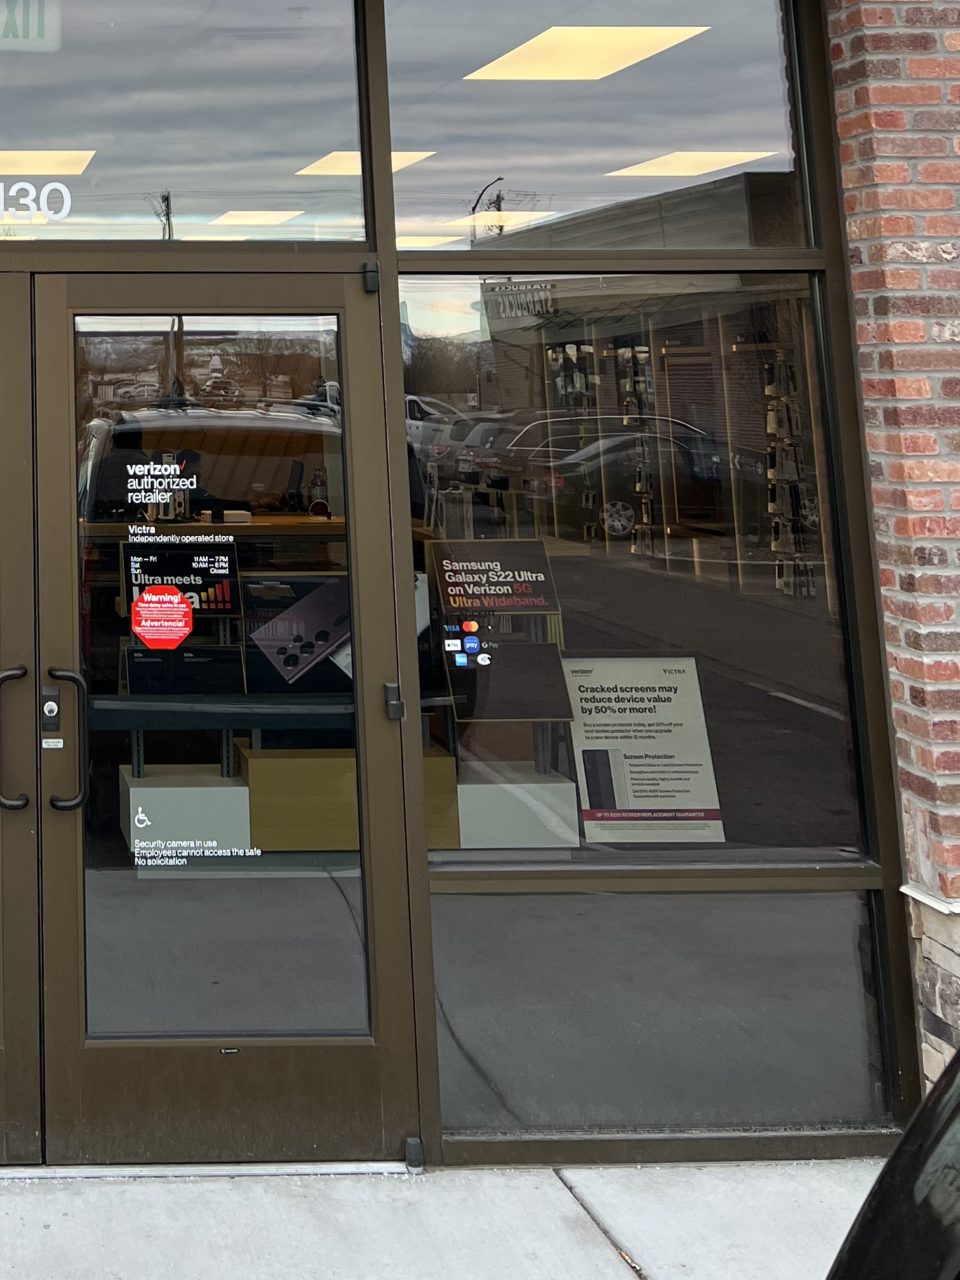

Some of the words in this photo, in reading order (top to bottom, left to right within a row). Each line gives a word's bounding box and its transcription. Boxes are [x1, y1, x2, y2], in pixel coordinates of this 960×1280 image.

[126, 461, 180, 475] verizon
[127, 474, 197, 489] authorized
[127, 489, 172, 503] retailer
[128, 525, 156, 534] Victra
[128, 534, 180, 543] Independently
[181, 534, 214, 543] operated
[442, 560, 501, 572] Samsung
[132, 574, 161, 585] Ultra
[163, 574, 203, 585] meets
[444, 571, 487, 583] Galaxy
[488, 571, 515, 582] S22
[515, 570, 545, 581] Ultra
[448, 586, 464, 595] on
[464, 584, 512, 595] Verizon
[513, 583, 533, 593] 5G
[142, 593, 182, 603] Warning!
[450, 596, 480, 607] Ultra
[481, 596, 549, 607] Wideband.
[578, 684, 618, 693] Cracked
[658, 686, 678, 694] may
[580, 695, 613, 703] reduce
[614, 695, 645, 703] device
[646, 695, 672, 703] value
[581, 705, 593, 715] by
[594, 705, 616, 714] 50%
[629, 705, 657, 714] more!
[134, 839, 165, 849] Security
[134, 848, 176, 857] Employees
[177, 848, 203, 856] cannot
[231, 847, 244, 856] the
[245, 847, 262, 856] safe
[134, 857, 146, 866] No
[147, 856, 187, 866] solicitation
